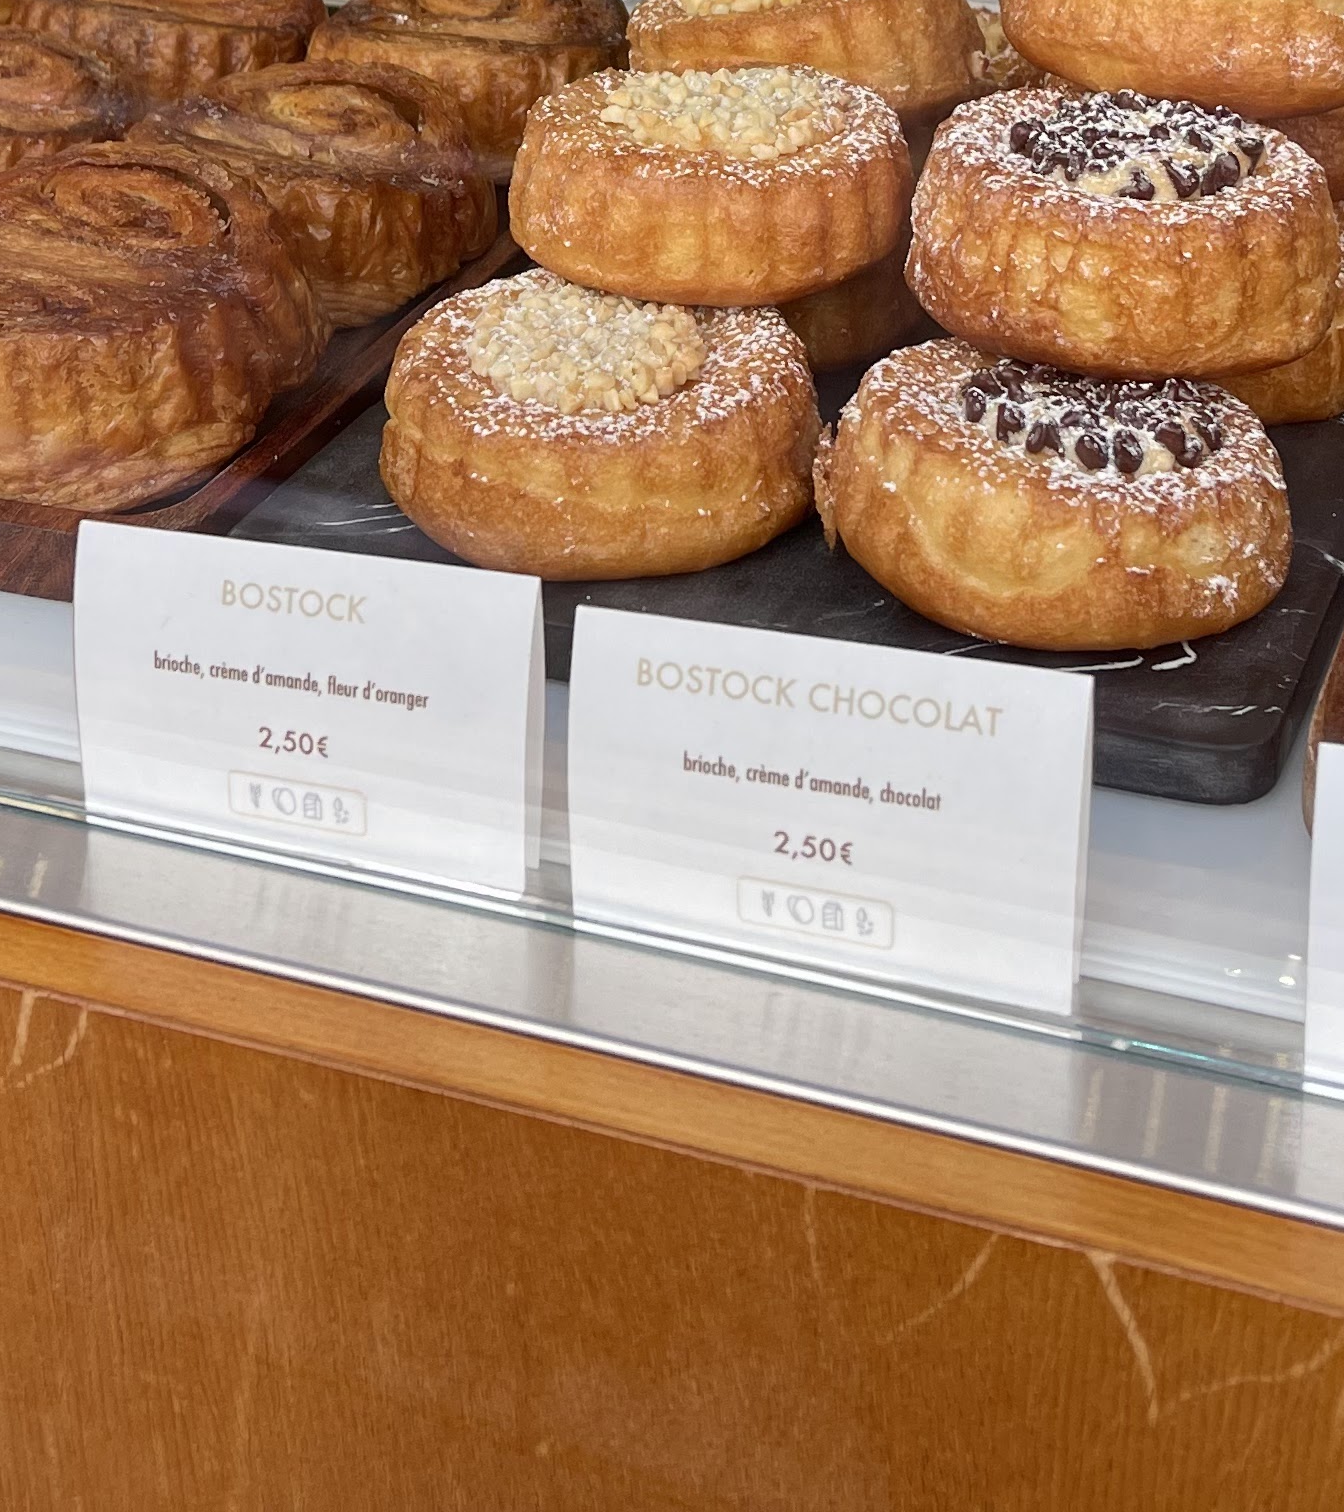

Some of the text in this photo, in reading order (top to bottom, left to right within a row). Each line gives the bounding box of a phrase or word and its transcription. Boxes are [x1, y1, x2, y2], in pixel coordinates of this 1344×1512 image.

[220, 579, 367, 625] BOSTOCK
[154, 650, 204, 679] brioche,
[209, 662, 248, 683] crème
[327, 675, 359, 699] fleur
[636, 657, 1004, 738] BOSTOCK CHOCOLAT
[258, 726, 329, 759] 2,50€
[682, 750, 740, 783] brioche,
[746, 764, 790, 787] crème
[880, 782, 942, 811] chocolat
[773, 830, 854, 866] 2,50€
